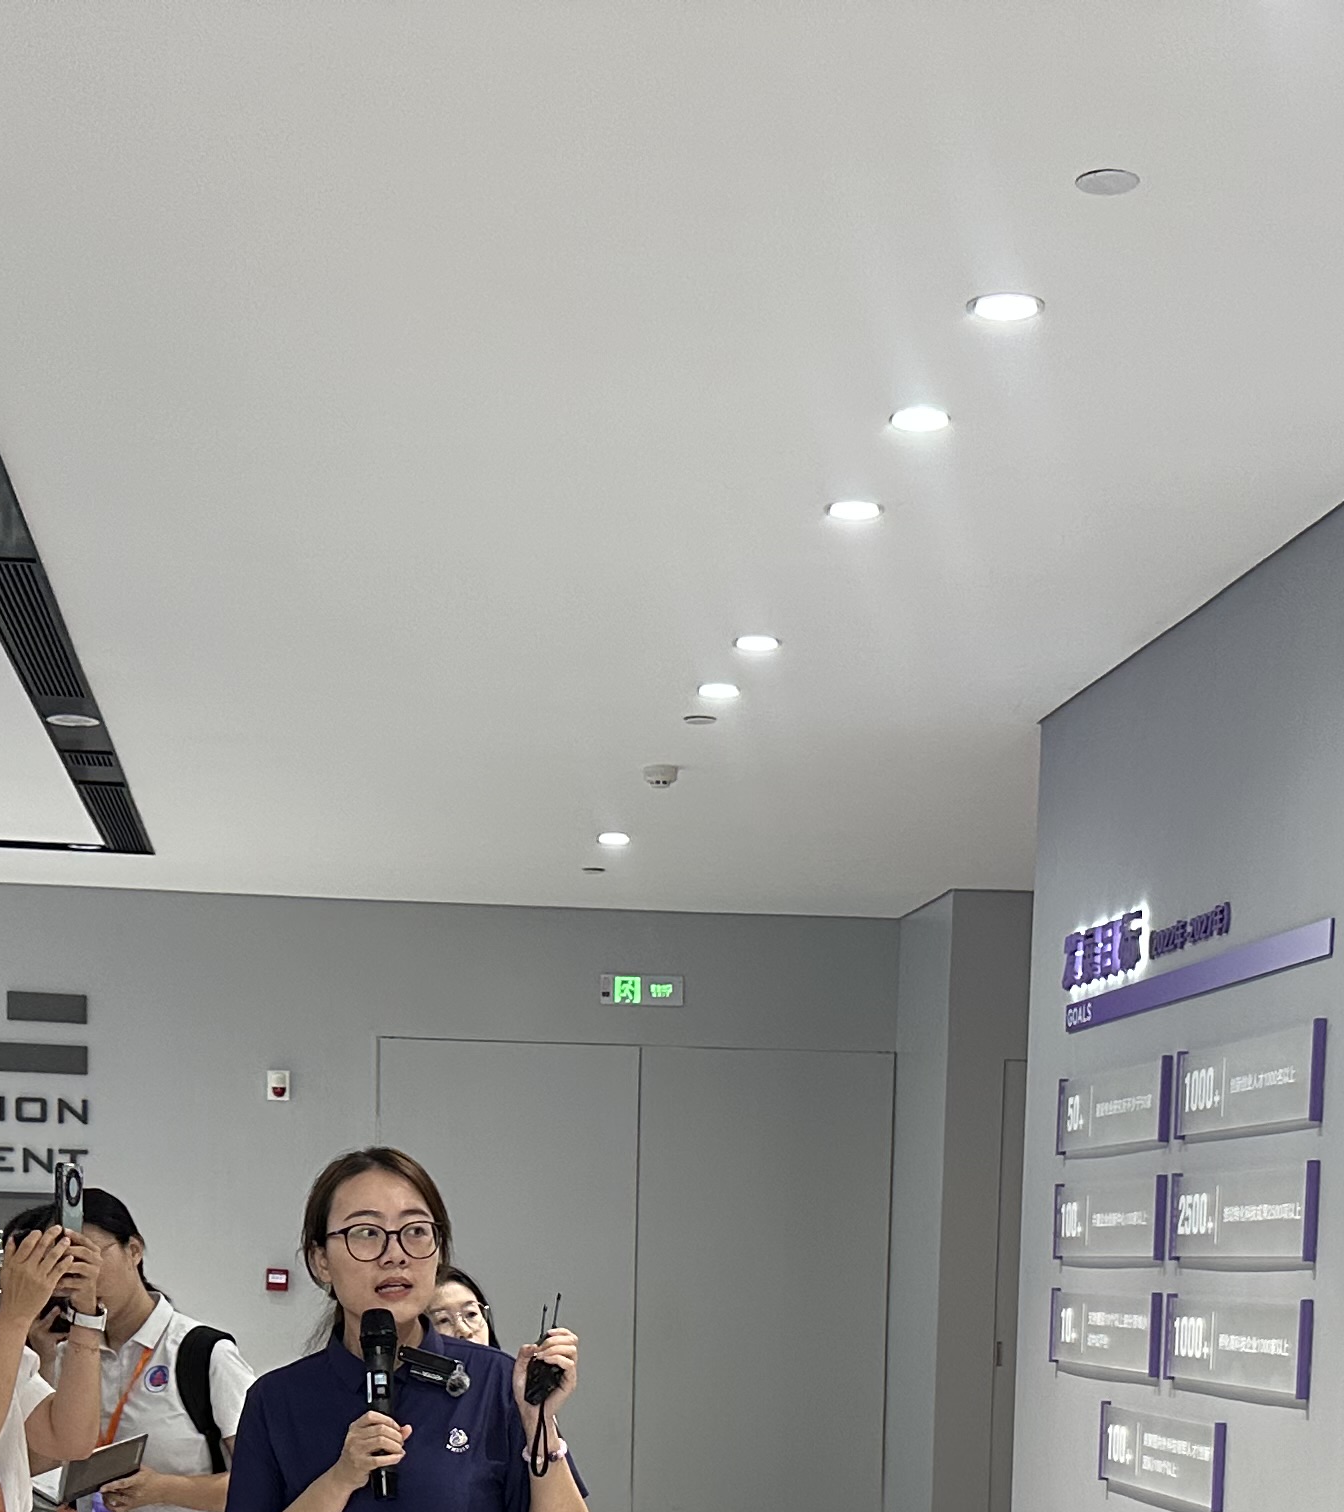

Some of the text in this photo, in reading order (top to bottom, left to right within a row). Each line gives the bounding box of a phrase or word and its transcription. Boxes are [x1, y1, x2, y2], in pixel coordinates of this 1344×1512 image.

[1067, 1003, 1092, 1027] GOALS
[1184, 1067, 1220, 1112] 1000+
[1067, 1095, 1084, 1131] 50+
[1061, 1202, 1082, 1238] 100+
[1177, 1193, 1213, 1235] 2500+
[1060, 1308, 1077, 1343] 10+
[1174, 1316, 1209, 1359] 1000+
[1107, 1425, 1132, 1464] 100+
